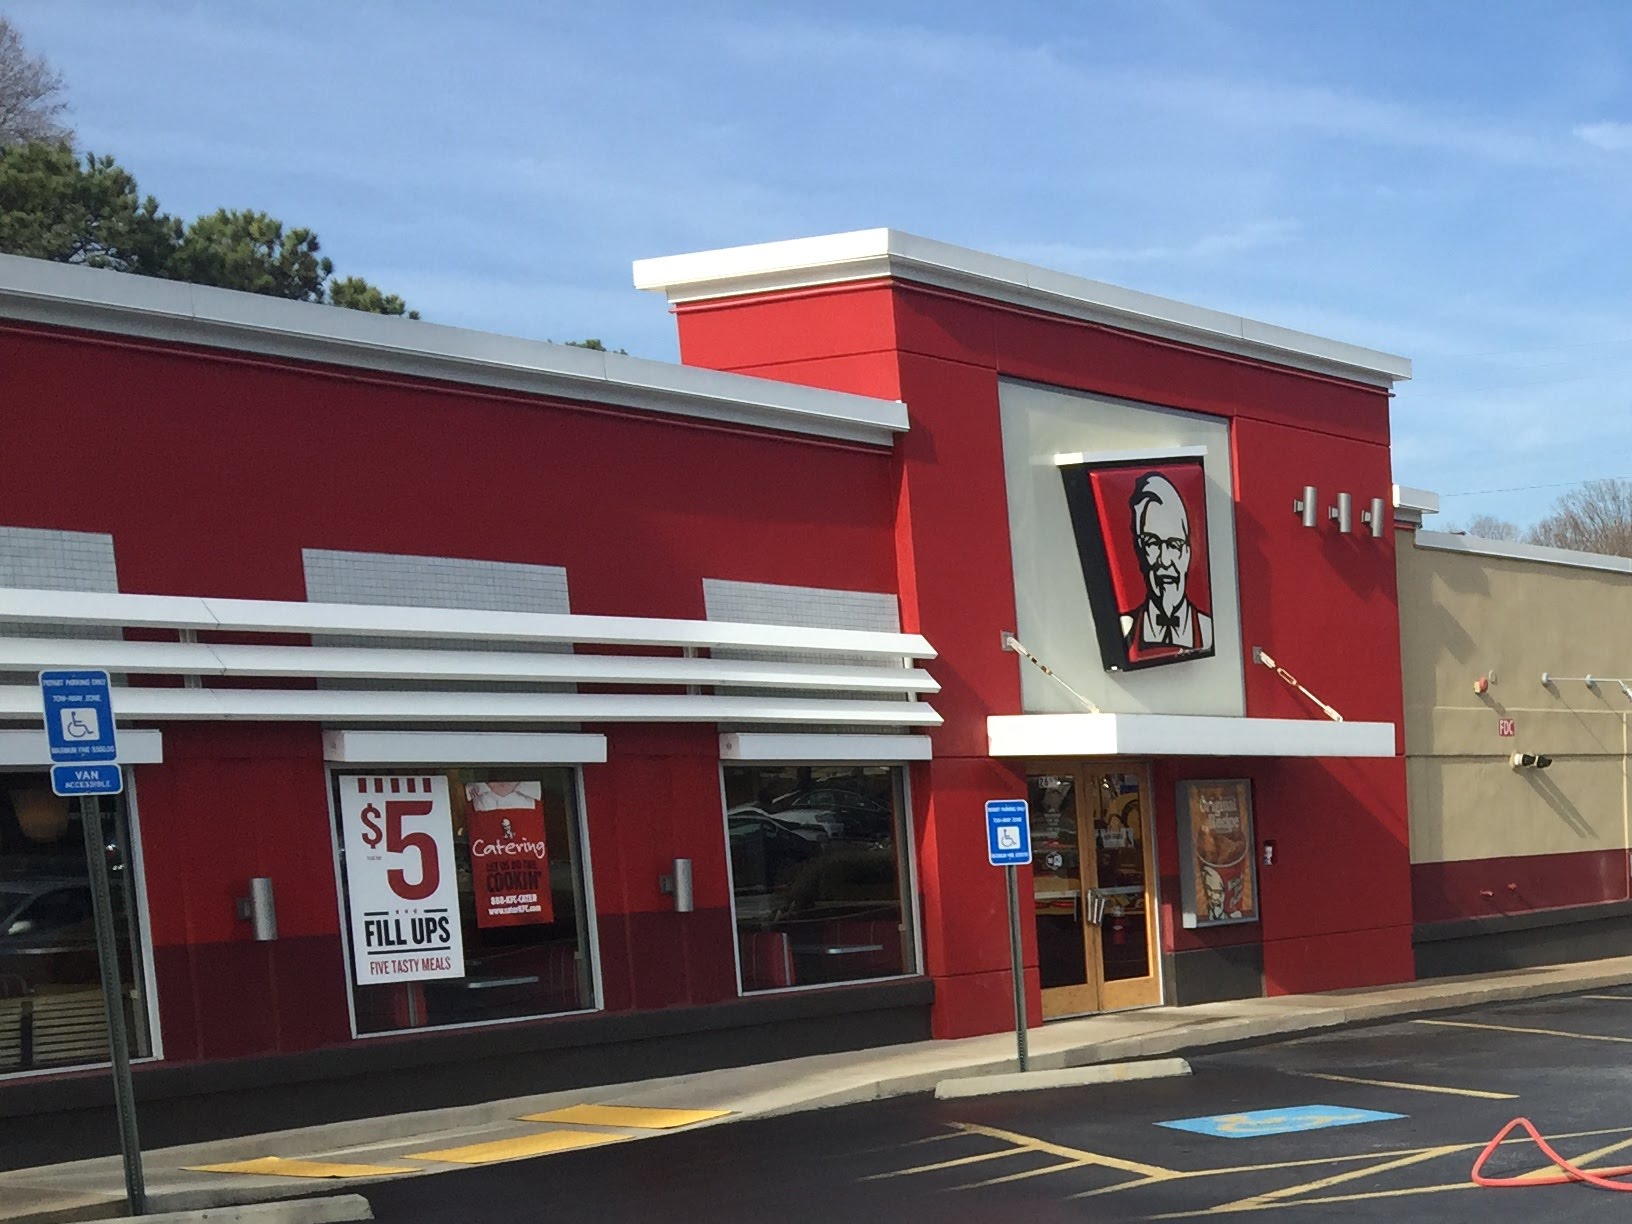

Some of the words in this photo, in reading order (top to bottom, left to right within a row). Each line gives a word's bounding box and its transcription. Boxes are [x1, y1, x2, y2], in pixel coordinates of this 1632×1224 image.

[1499, 719, 1514, 735] FDC
[75, 770, 99, 779] VAN
[1208, 814, 1239, 833] Recipe
[361, 801, 440, 900] $5
[473, 838, 545, 858] Catering
[364, 919, 407, 946] FILL
[411, 917, 450, 944] UPS
[370, 961, 390, 976] FIVE
[391, 958, 419, 974] TASTY
[421, 956, 452, 973] MEALS
